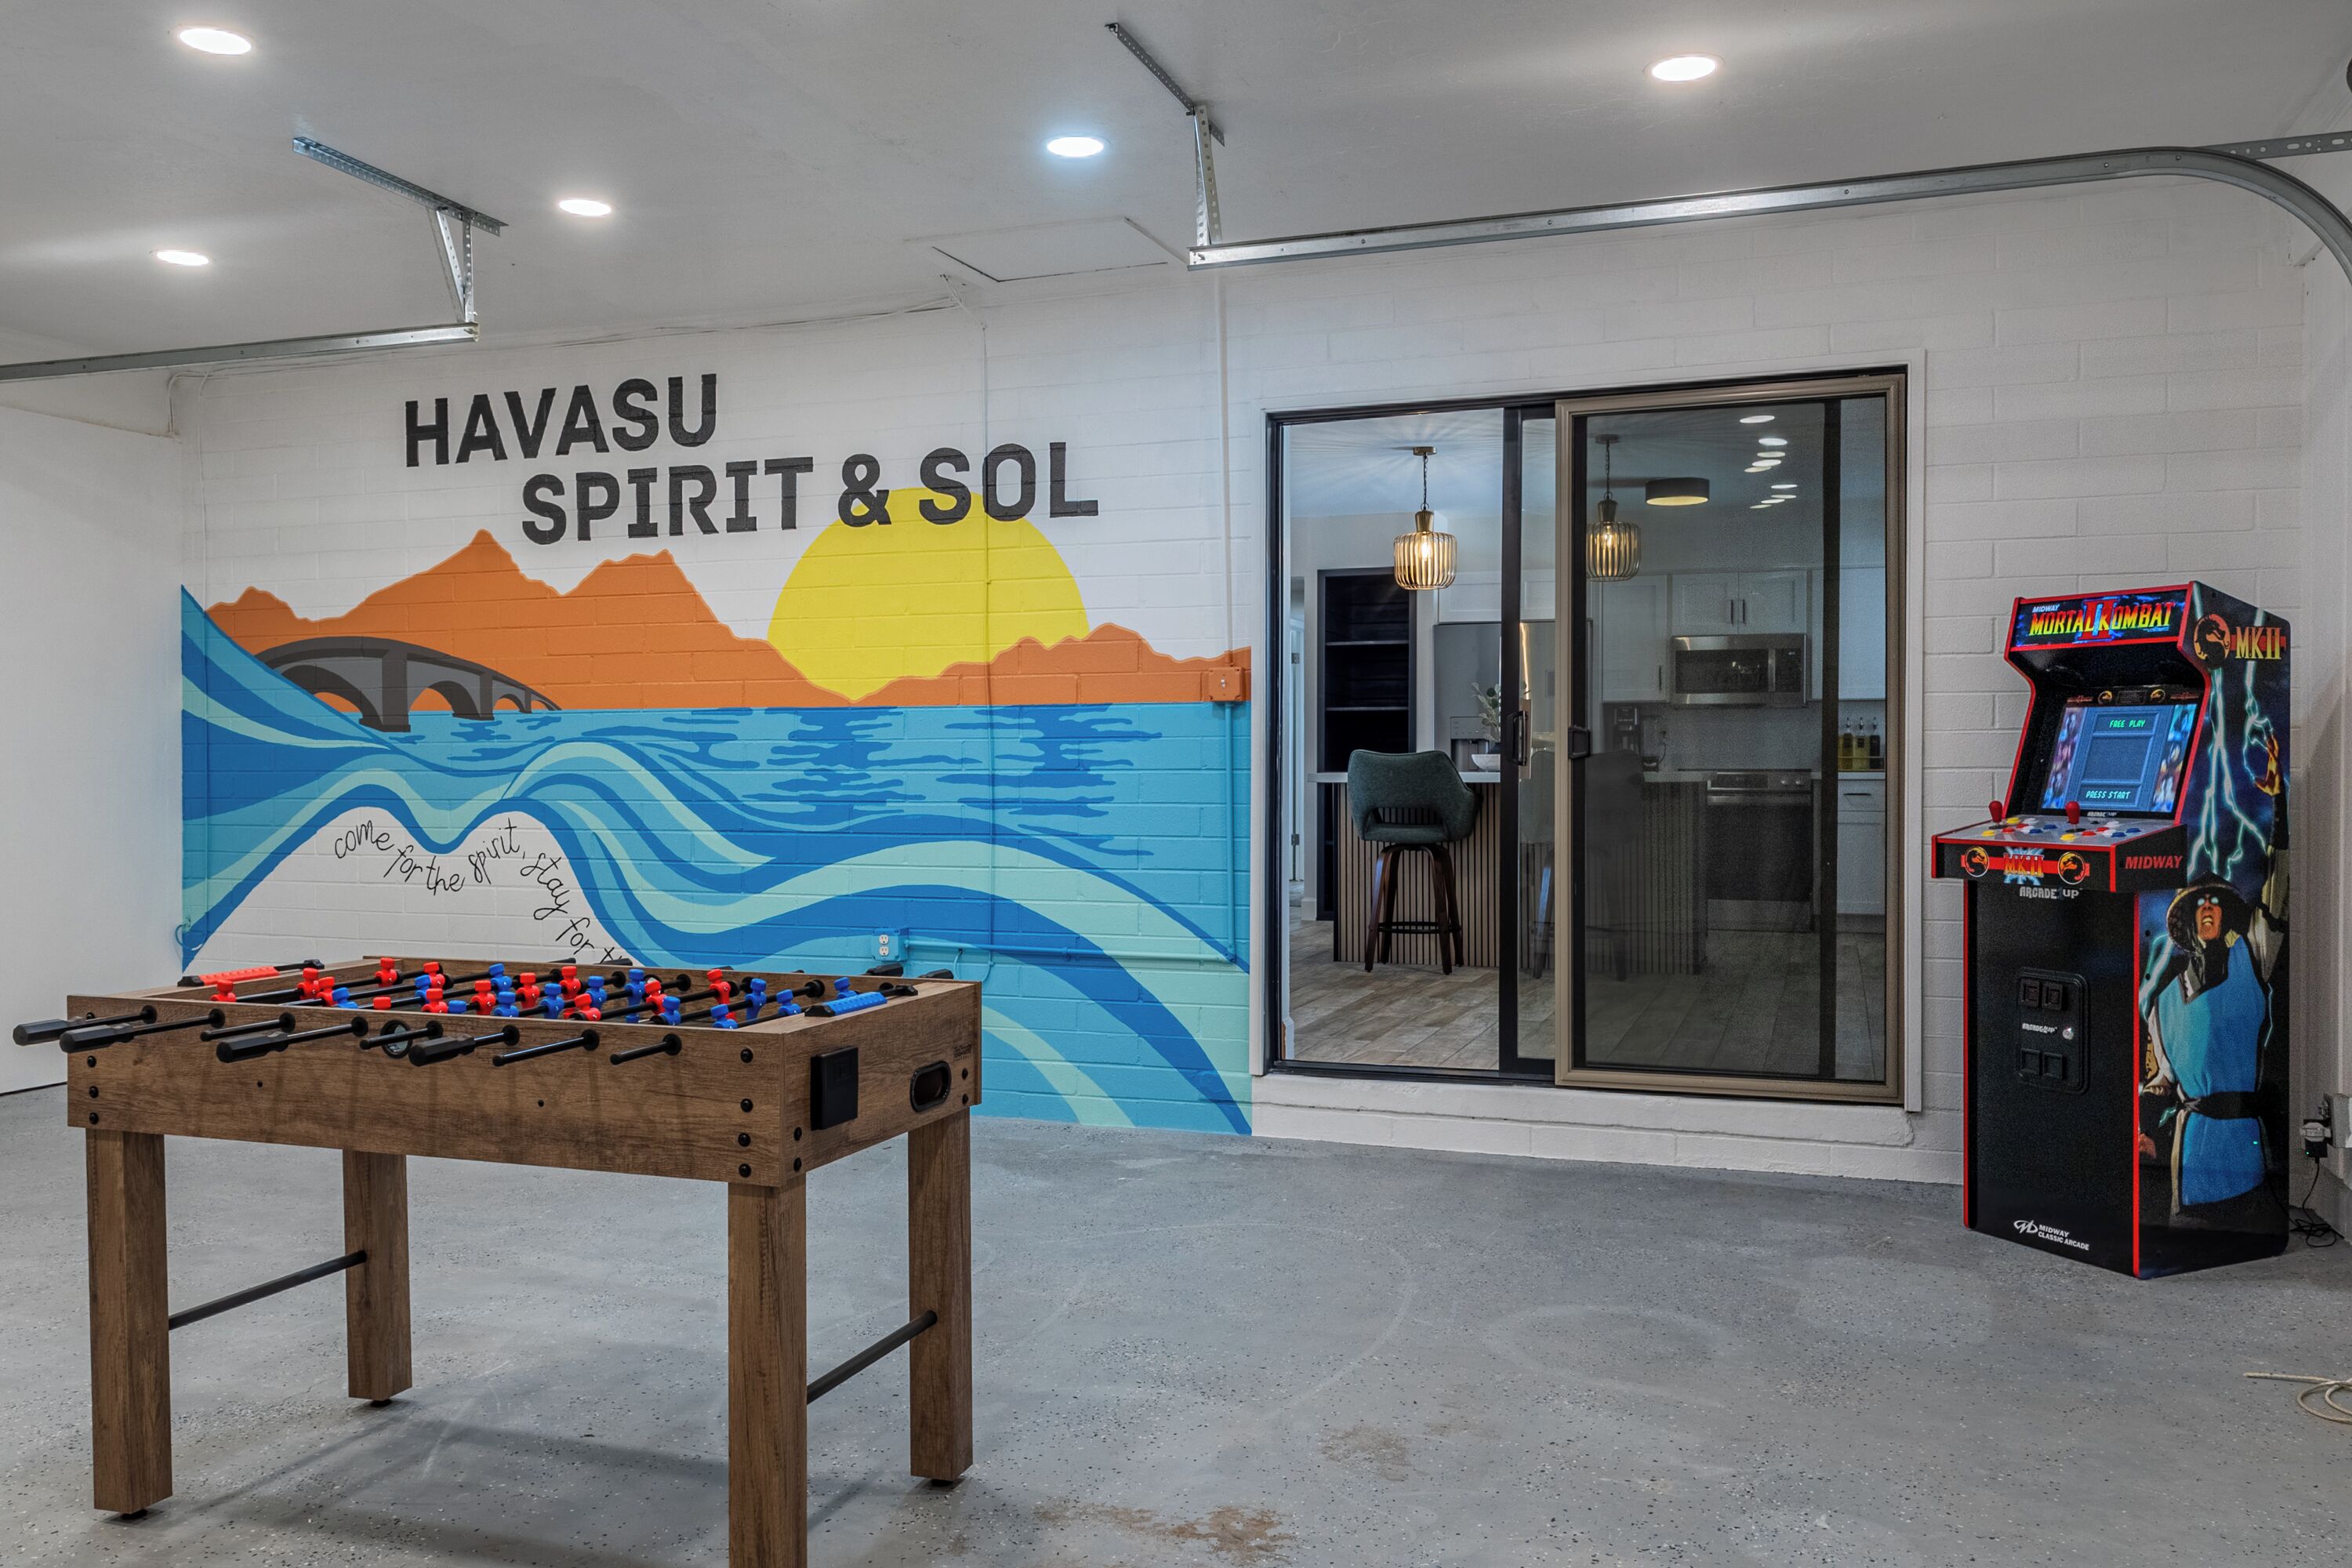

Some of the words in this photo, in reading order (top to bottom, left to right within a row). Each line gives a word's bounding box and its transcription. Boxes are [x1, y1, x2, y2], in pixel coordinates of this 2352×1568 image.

[405, 373, 717, 467] HAVASU
[521, 456, 814, 544] SPIRIT
[837, 453, 892, 527] &
[918, 441, 1098, 525] SOL
[2031, 604, 2060, 614] MIDWAY
[2029, 608, 2095, 637] MORTAL
[2098, 601, 2176, 632] KOMBAT
[2234, 626, 2282, 660] MKII
[2109, 719, 2125, 728] FREE
[2129, 719, 2146, 728] PLAY
[2085, 790, 2107, 799] PRESS
[2108, 790, 2132, 800] START
[2125, 855, 2183, 869] MIDWAY
[335, 819, 394, 858] come
[383, 844, 423, 882] for
[426, 855, 466, 896] the
[468, 817, 526, 884] spirit,
[520, 852, 571, 920] stay
[556, 916, 595, 955] for
[2038, 1224, 2070, 1238] MIDWAY
[2038, 1231, 2063, 1243] CLASSIC
[2063, 1239, 2090, 1250] ARCADE
